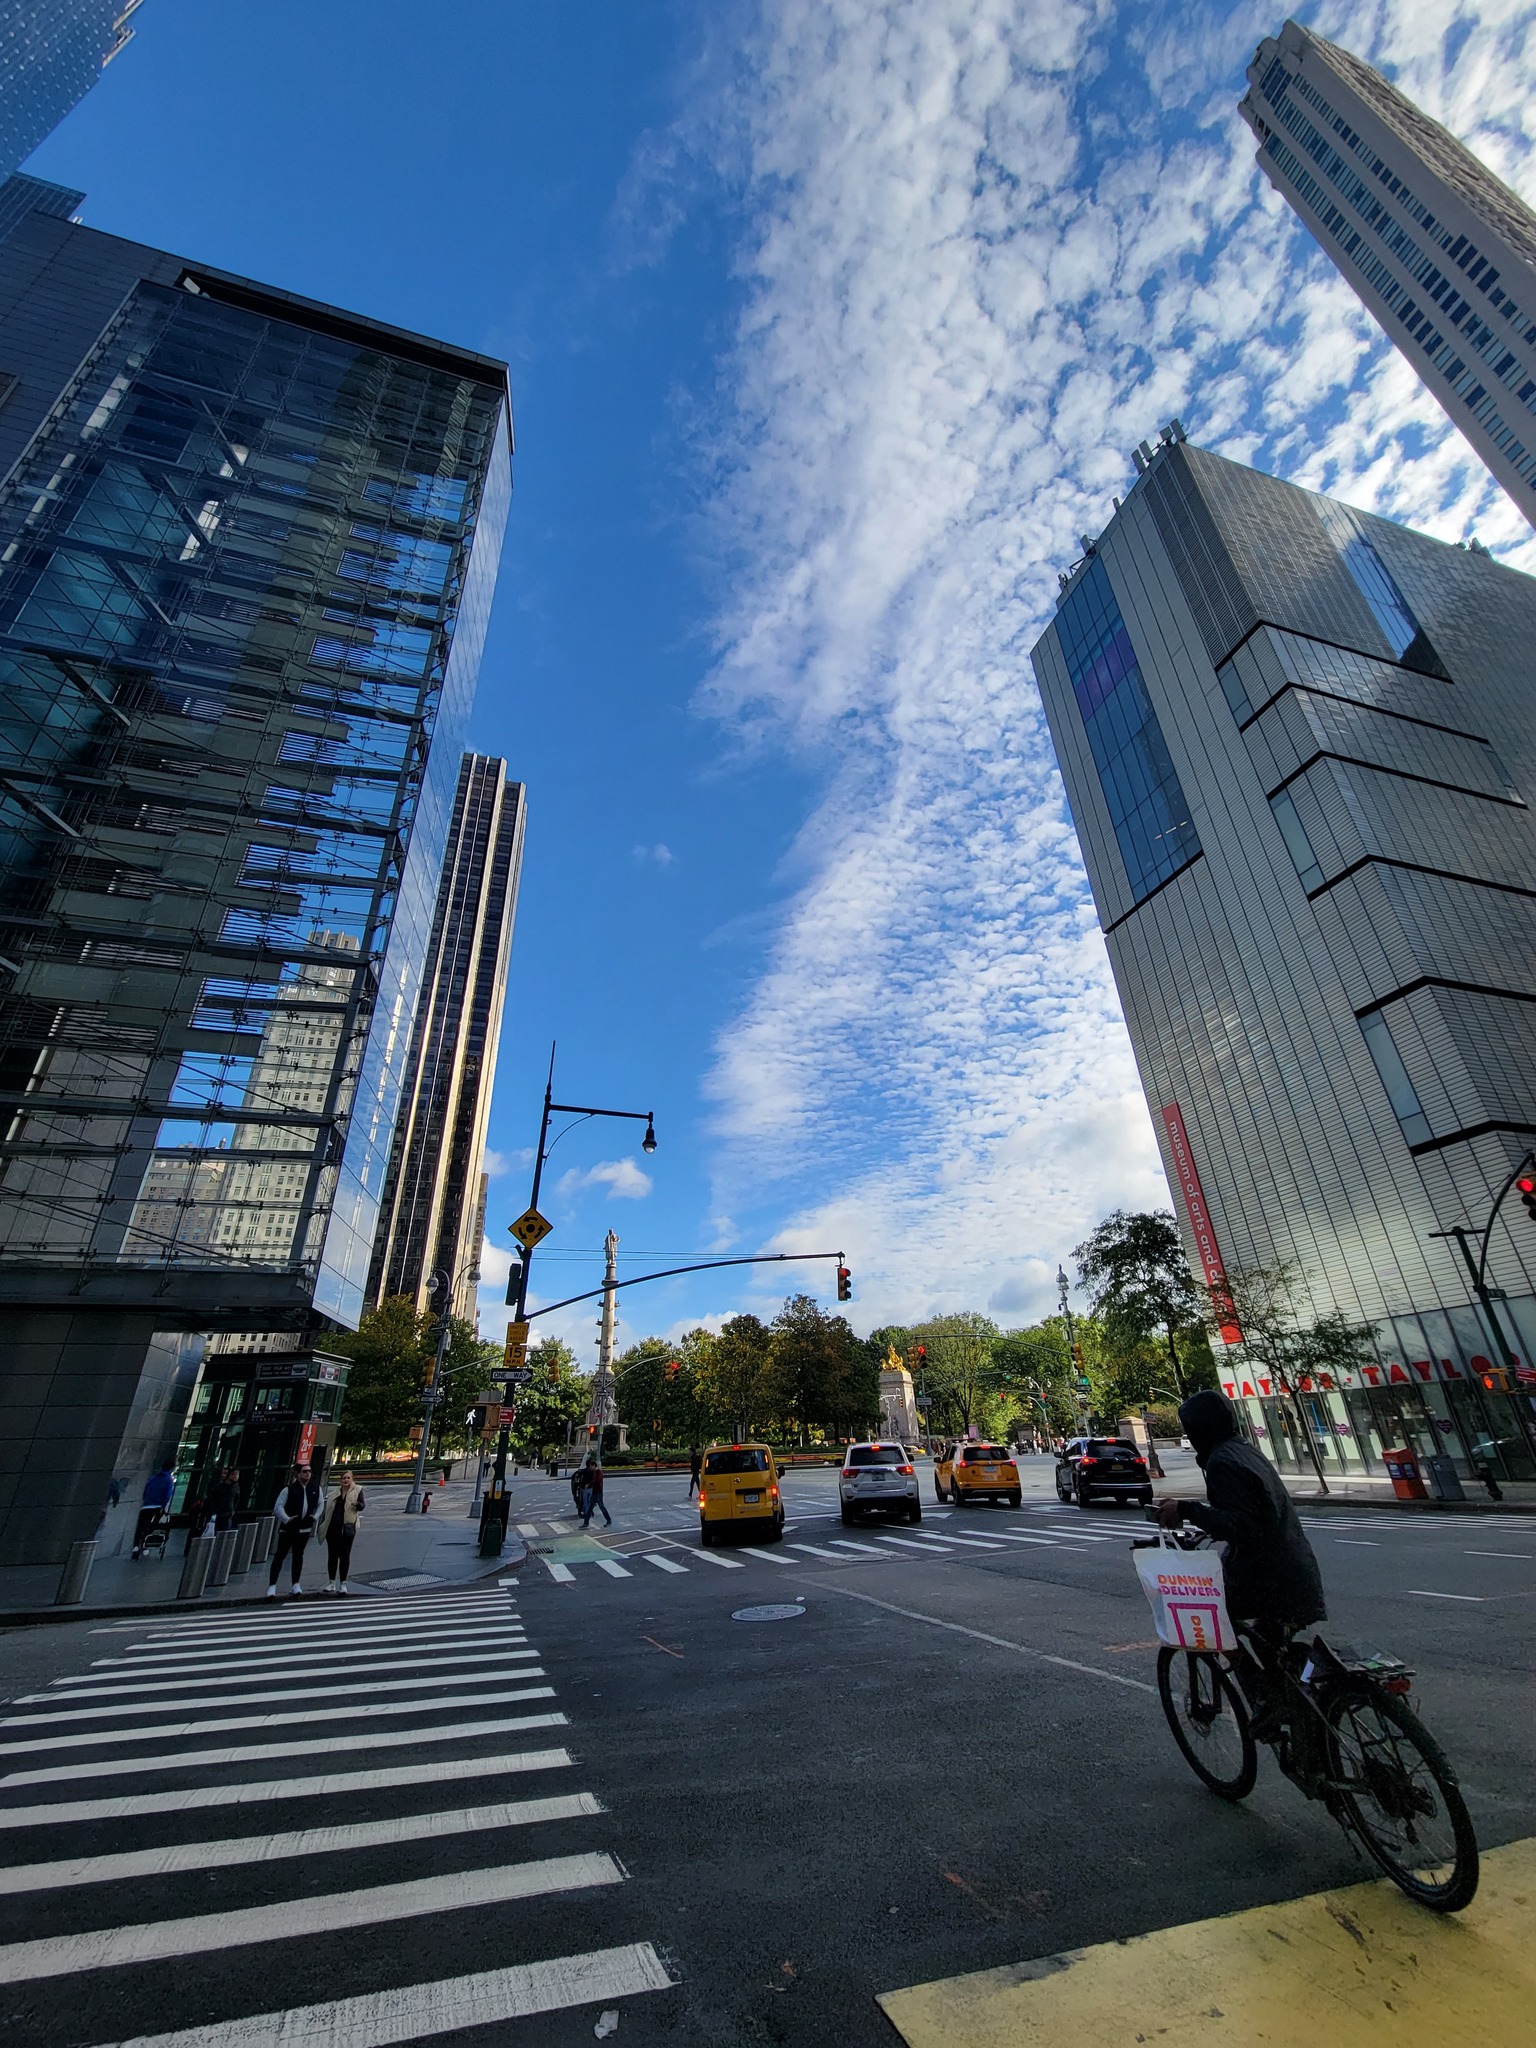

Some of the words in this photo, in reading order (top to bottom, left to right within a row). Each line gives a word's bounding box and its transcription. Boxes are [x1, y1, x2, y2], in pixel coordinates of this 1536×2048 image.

[1169, 1121, 1191, 1180] museum
[1186, 1183, 1200, 1198] of
[1191, 1202, 1205, 1231] arts
[1200, 1235, 1218, 1265] and
[509, 1347, 522, 1358] 15
[1157, 1574, 1213, 1587] DUNKIN'
[1157, 1585, 1221, 1597] DELIVERS
